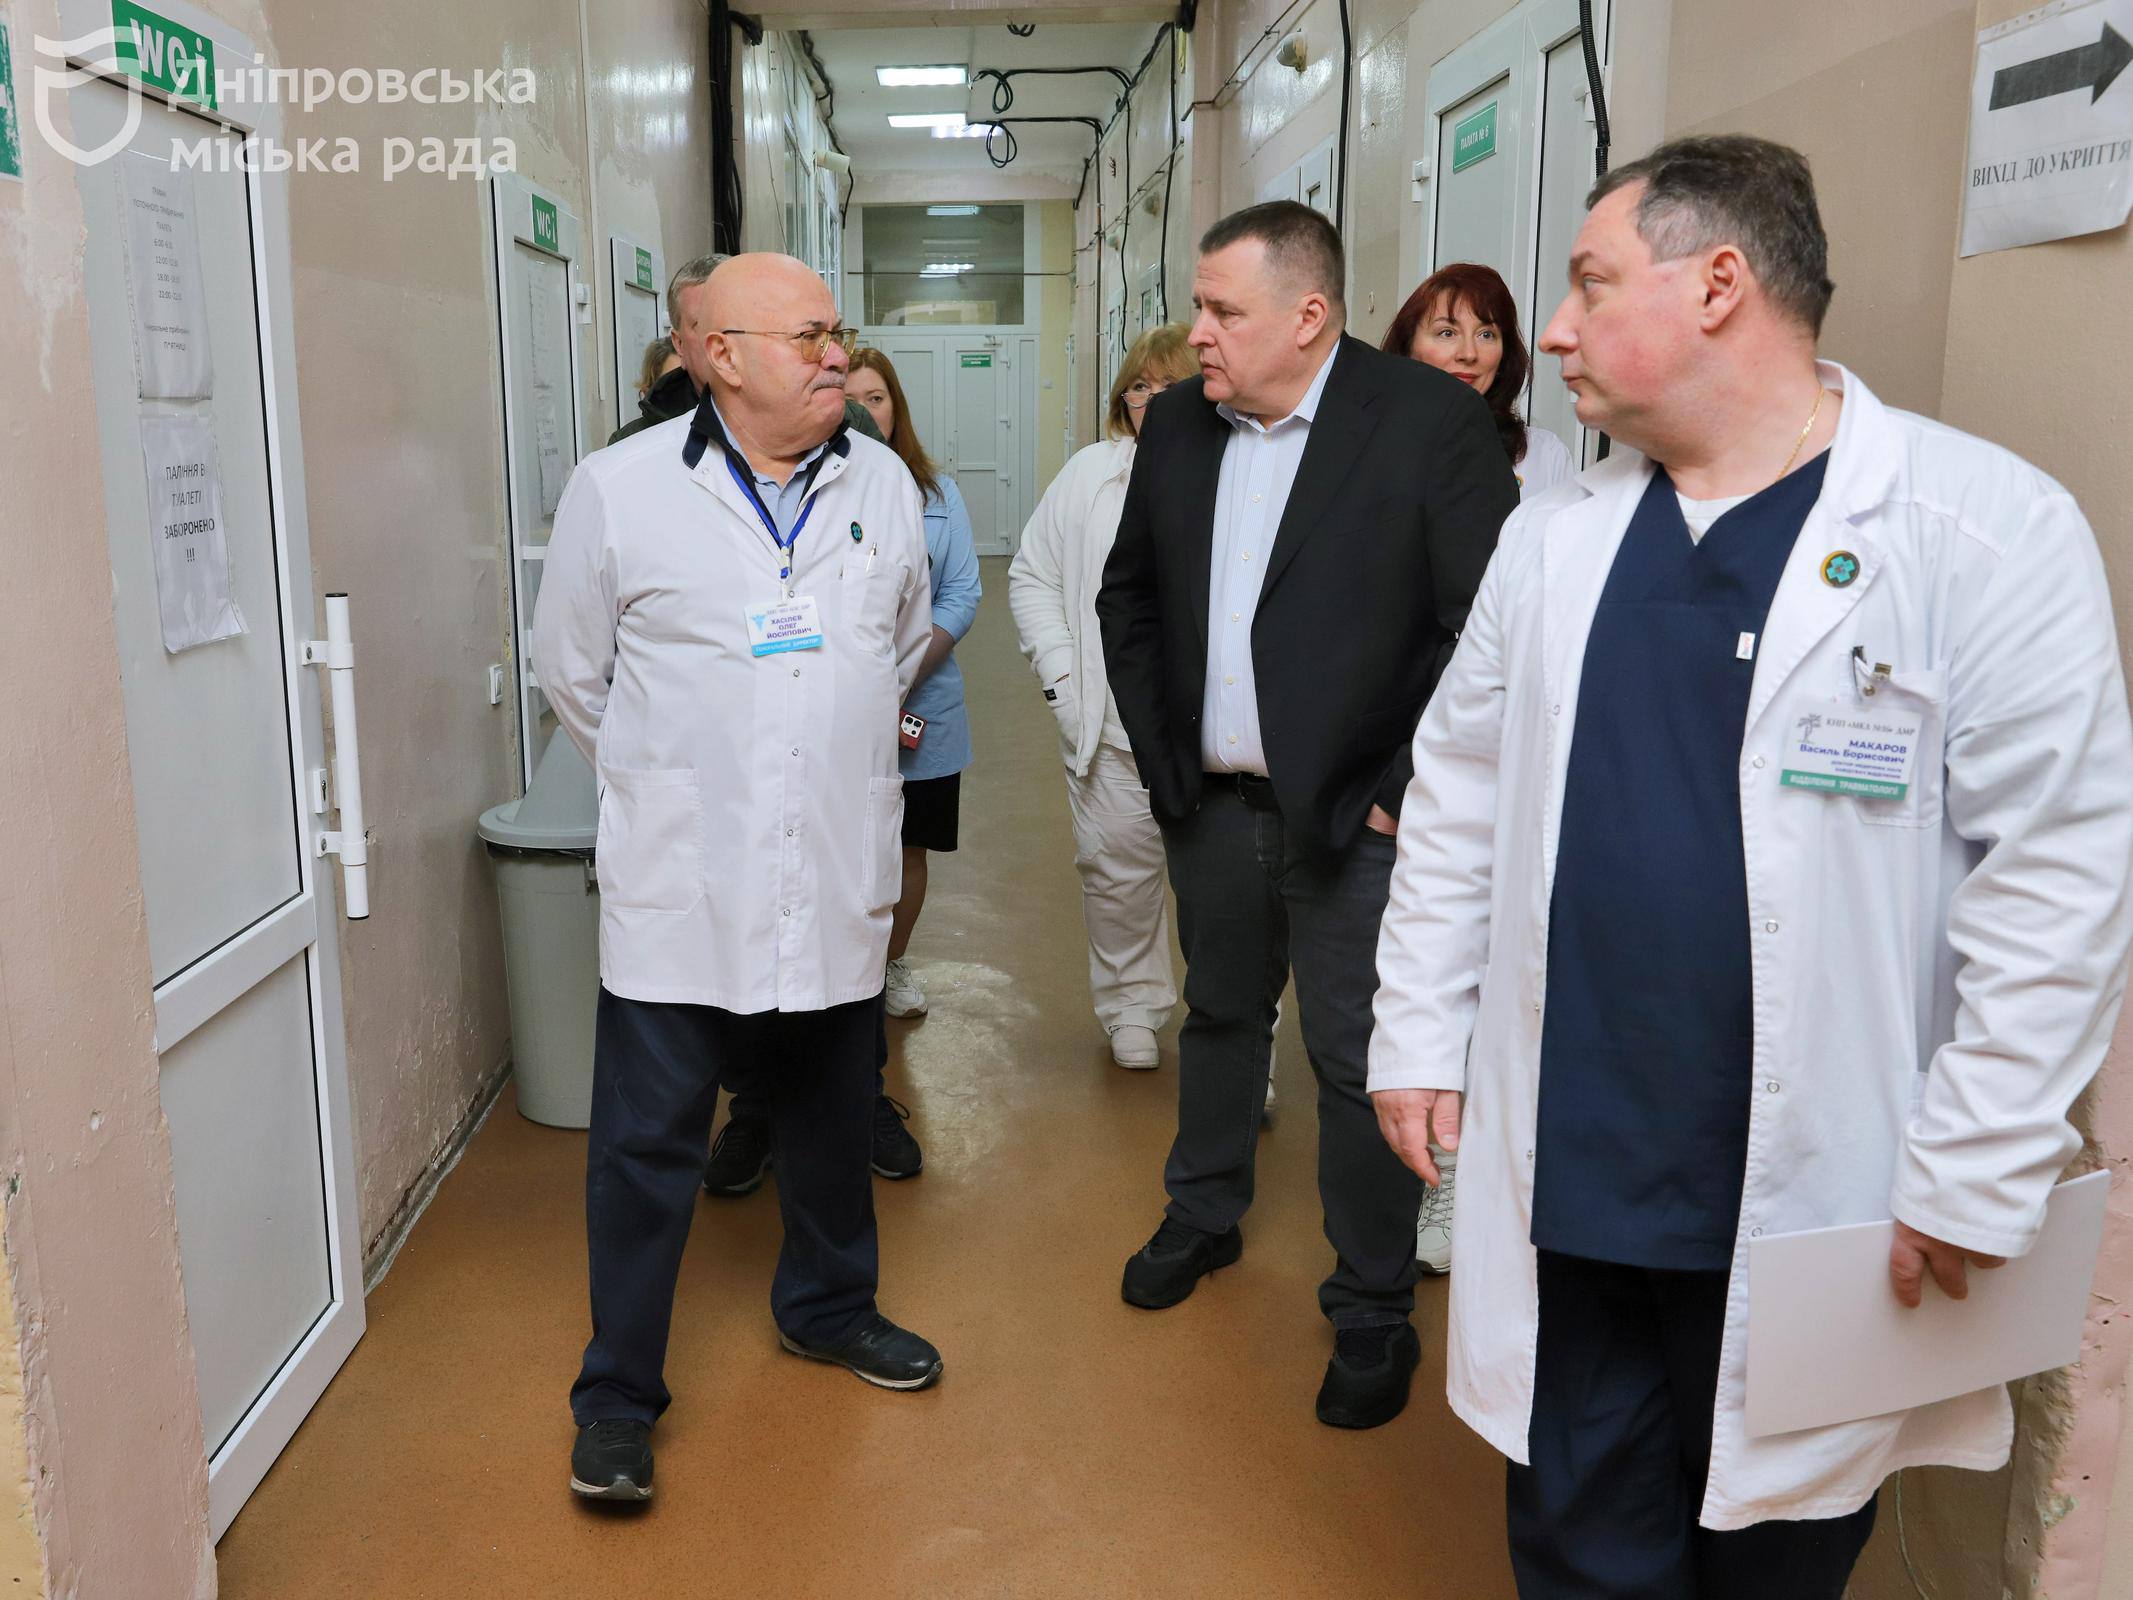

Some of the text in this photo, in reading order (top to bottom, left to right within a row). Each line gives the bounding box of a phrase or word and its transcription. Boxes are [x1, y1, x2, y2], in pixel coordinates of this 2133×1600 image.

[1972, 139, 2132, 188] ВИХІД ДО УКРИТТЯ
[536, 209, 551, 240] WC
[166, 463, 198, 480] ПАЛІННЯ
[172, 490, 201, 507] ТУАЛЕТІ
[164, 518, 215, 539] ЗАБОРОНЕНО
[186, 548, 196, 562] !!!
[779, 623, 797, 631] ОЛЕГ
[1800, 744, 1905, 764] Василь Борисович
[1849, 740, 1907, 755] МАКАРОВ
